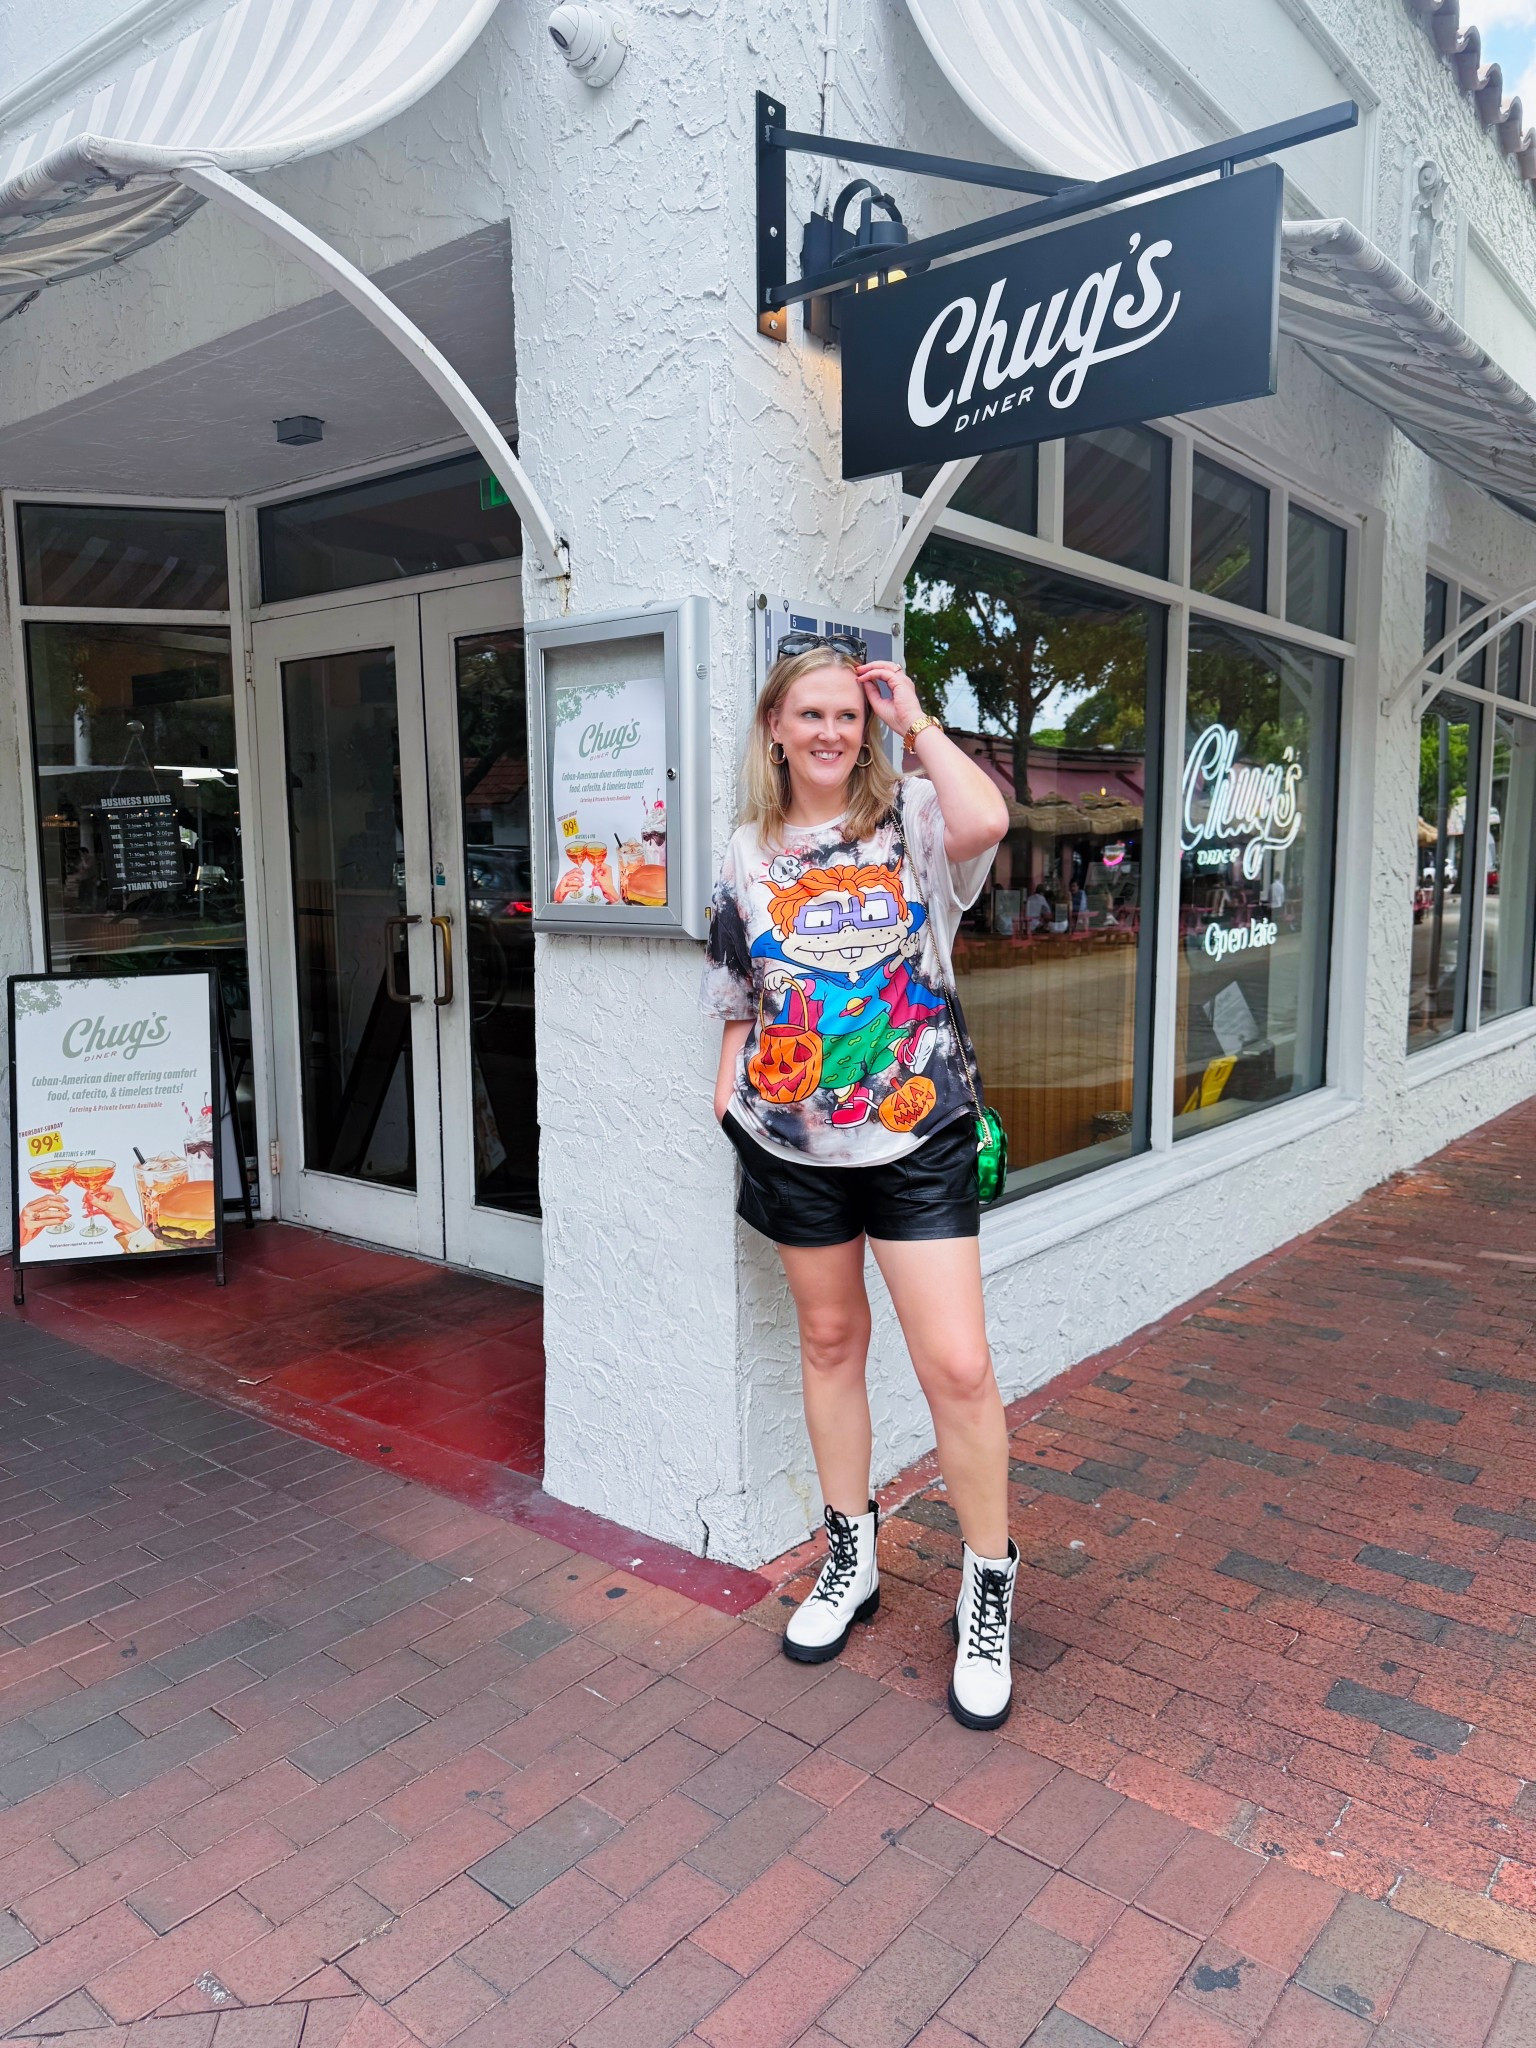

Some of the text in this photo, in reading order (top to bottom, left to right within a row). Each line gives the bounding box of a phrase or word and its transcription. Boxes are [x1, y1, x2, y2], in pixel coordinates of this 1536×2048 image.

[907, 232, 1181, 428] Chug's
[954, 385, 1034, 433] DINER
[792, 616, 798, 629] 5
[579, 718, 641, 760] Chug's
[632, 766, 654, 777] comfort
[101, 794, 171, 807] BUSINESS HOURS
[127, 880, 168, 891] THANK YOU
[1204, 922, 1248, 962] Open
[62, 1012, 171, 1060] Chug's
[83, 1050, 117, 1062] DINER
[32, 1067, 197, 1087] Cuban-American diner offering comfort
[47, 1083, 184, 1101] food, cafecito, & timeless treats!
[69, 1105, 92, 1113] Catering
[98, 1104, 118, 1112] Private
[118, 1103, 136, 1111] Events
[137, 1101, 163, 1110] Available
[30, 1132, 60, 1154] 99¢
